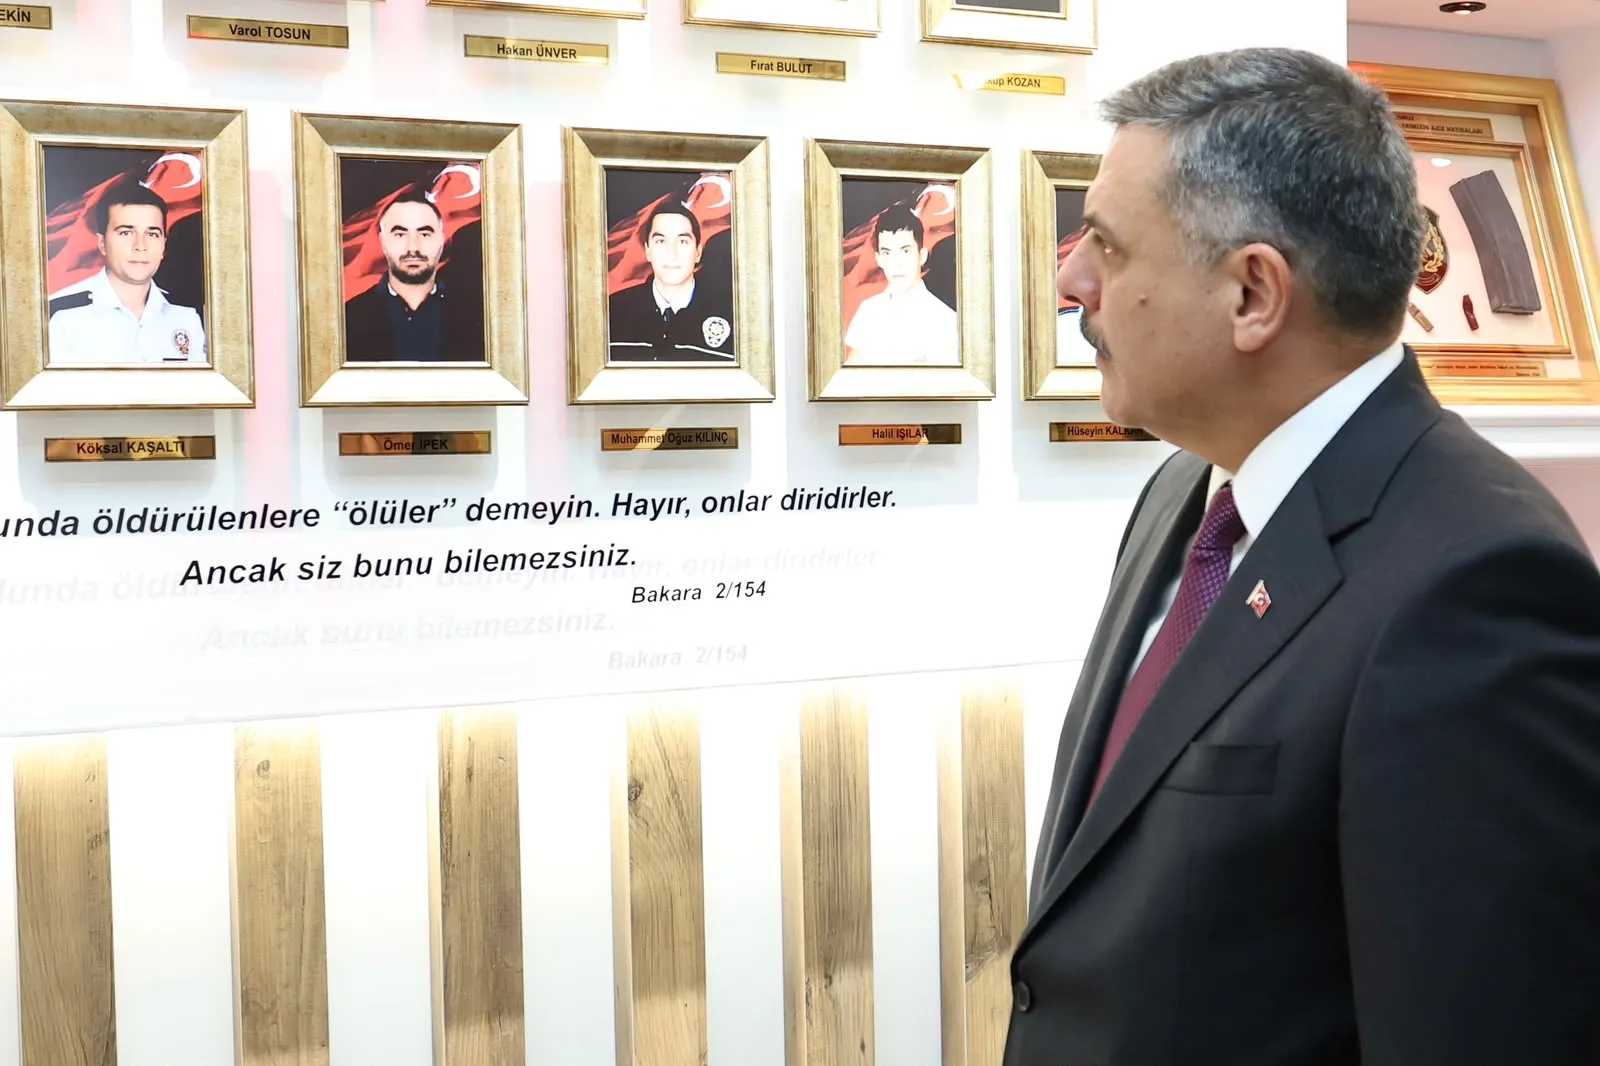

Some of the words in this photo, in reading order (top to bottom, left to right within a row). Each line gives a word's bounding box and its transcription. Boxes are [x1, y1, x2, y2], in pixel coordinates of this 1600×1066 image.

[229, 24, 262, 37] Varol
[266, 26, 311, 40] TOSUN
[497, 44, 533, 56] Hakan
[536, 44, 577, 59] ÜNVER
[750, 60, 774, 72] Fırat
[777, 62, 812, 74] BULUT
[1007, 77, 1041, 88] KOZAN
[611, 433, 666, 445] Muhammet
[667, 433, 693, 445] Oğuz
[695, 432, 728, 445] KILINÇ
[872, 428, 894, 438] Halil
[896, 428, 929, 440] IŞILAR
[1067, 426, 1103, 438] Hüseyin
[76, 442, 123, 454] Köksal
[127, 440, 185, 455] KAŞALTI
[383, 437, 416, 450] Ömer
[92, 503, 320, 535] öldürülenlere
[465, 494, 601, 526] demeyin.
[611, 492, 691, 522] Hayır,
[701, 489, 773, 514] onlar
[780, 485, 897, 511] diridirler.
[179, 556, 286, 586] Ancak
[297, 554, 342, 581] siz
[353, 553, 433, 578] bunu
[444, 543, 636, 574] bilemezsiniz.
[631, 585, 702, 604] Bakara
[715, 580, 766, 599] 2/154
